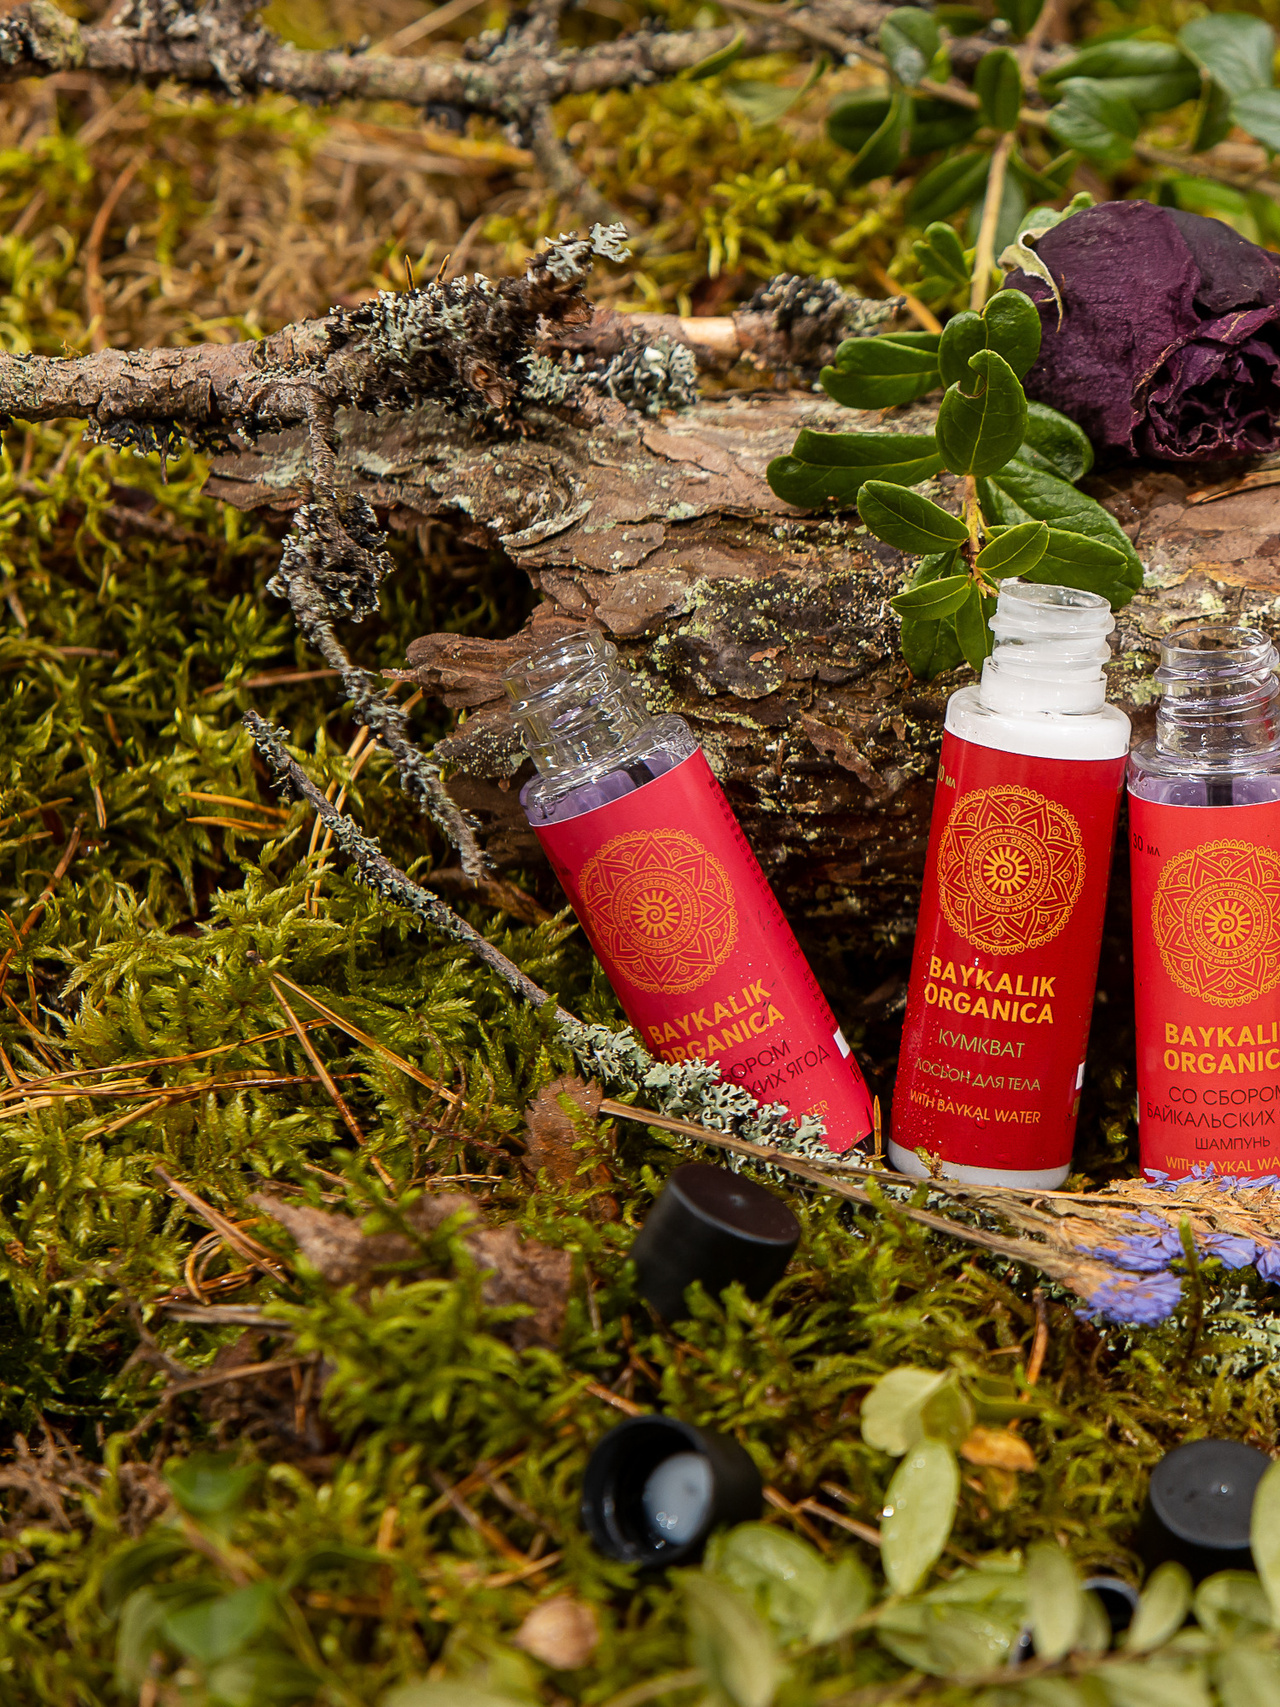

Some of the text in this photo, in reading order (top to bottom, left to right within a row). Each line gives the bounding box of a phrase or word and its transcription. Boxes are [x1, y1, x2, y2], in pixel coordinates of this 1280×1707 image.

[945, 776, 956, 789] мл
[1133, 833, 1160, 856] 30 мл
[930, 956, 1056, 997] BAYKALIK
[647, 978, 772, 1046] BAYKALIK
[925, 982, 1053, 1024] ORGANICA
[659, 1004, 785, 1064] ORGANICA
[939, 1028, 1025, 1058] КУМКВАТ
[721, 1040, 791, 1084] БОРОМ
[787, 1045, 831, 1079] ЯГОД
[915, 1057, 1041, 1090] ЛОСЬОН ДЛЯ ТЕЛА
[910, 1089, 1041, 1123] WITH BAYKAL WATER
[1169, 1087, 1197, 1104] СО
[1147, 1102, 1275, 1128] БАЙКАЛЬСКИХ
[1195, 1136, 1270, 1150] ШАМПУНЬ
[1166, 1155, 1196, 1170] WITH
